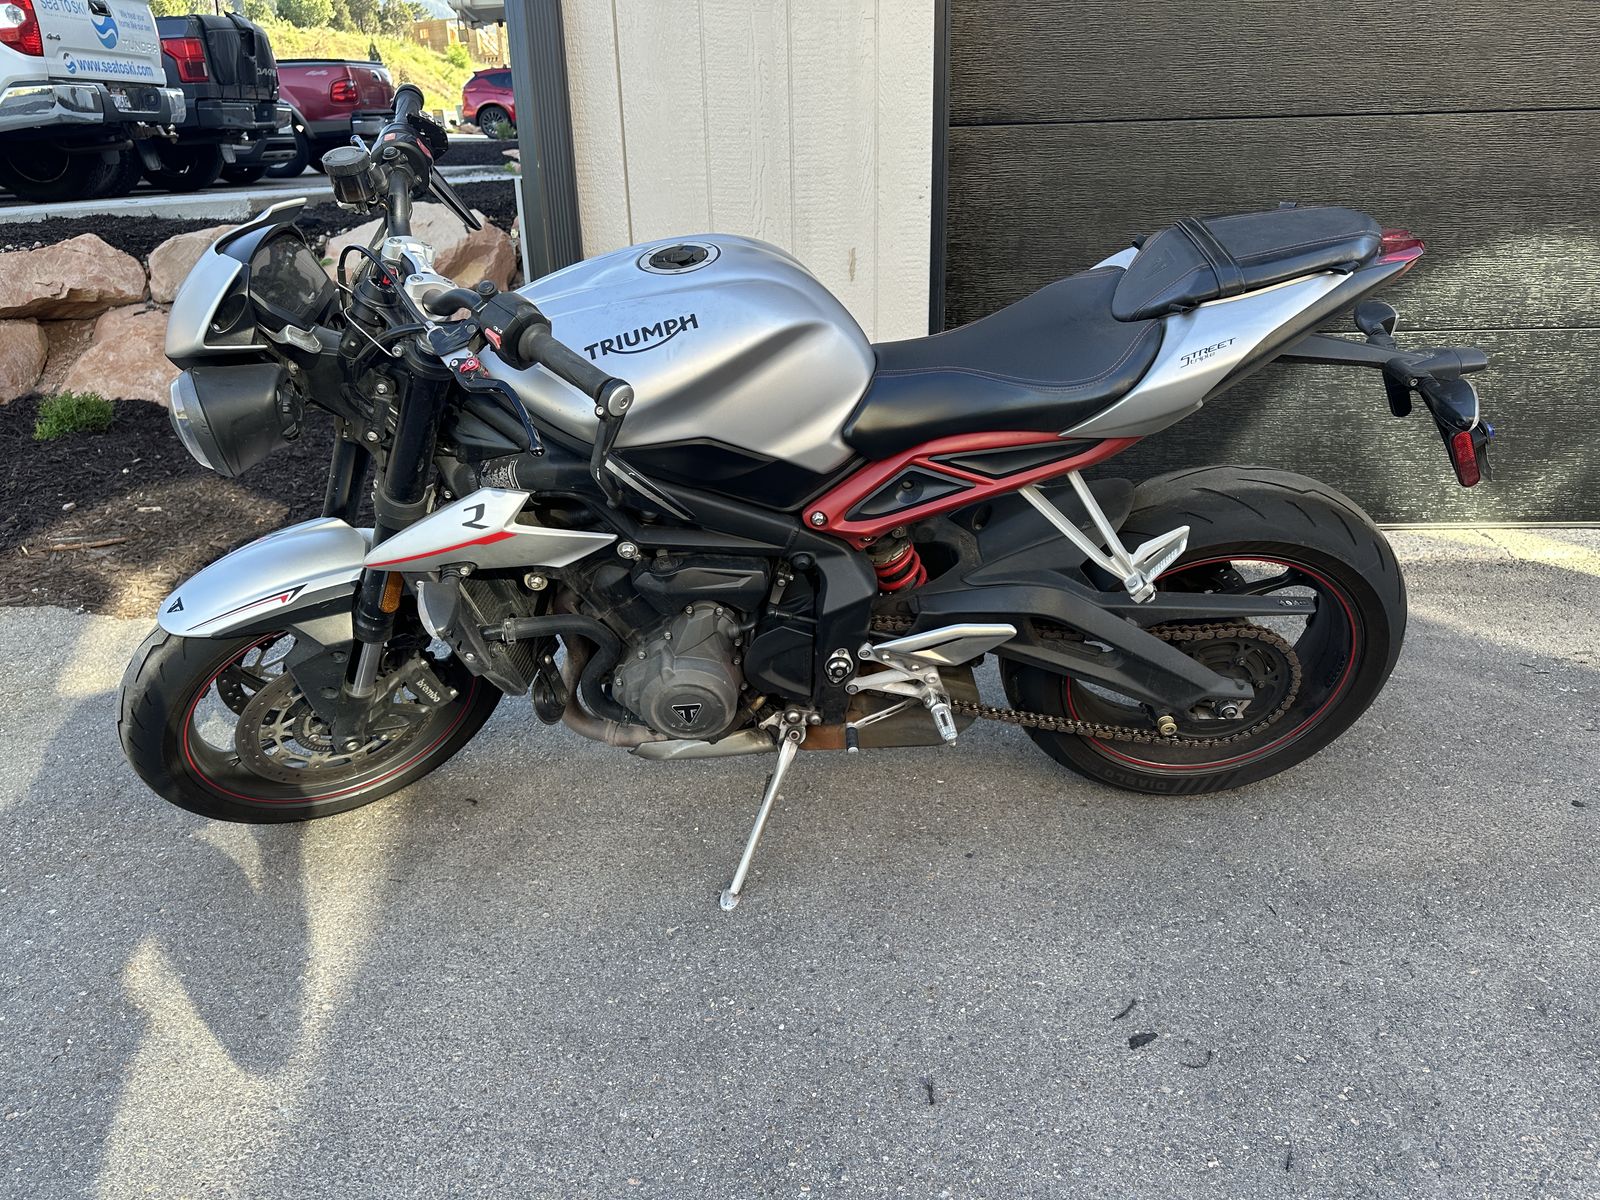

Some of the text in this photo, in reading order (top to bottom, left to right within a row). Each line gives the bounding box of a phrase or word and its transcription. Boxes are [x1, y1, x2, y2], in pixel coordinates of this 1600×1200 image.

[77, 59, 154, 77] www.seatoski.com
[584, 313, 699, 360] TRIUMPH
[1180, 337, 1237, 368] STREET
[416, 679, 441, 702] brembo
[1104, 768, 1168, 790] DIABLO
